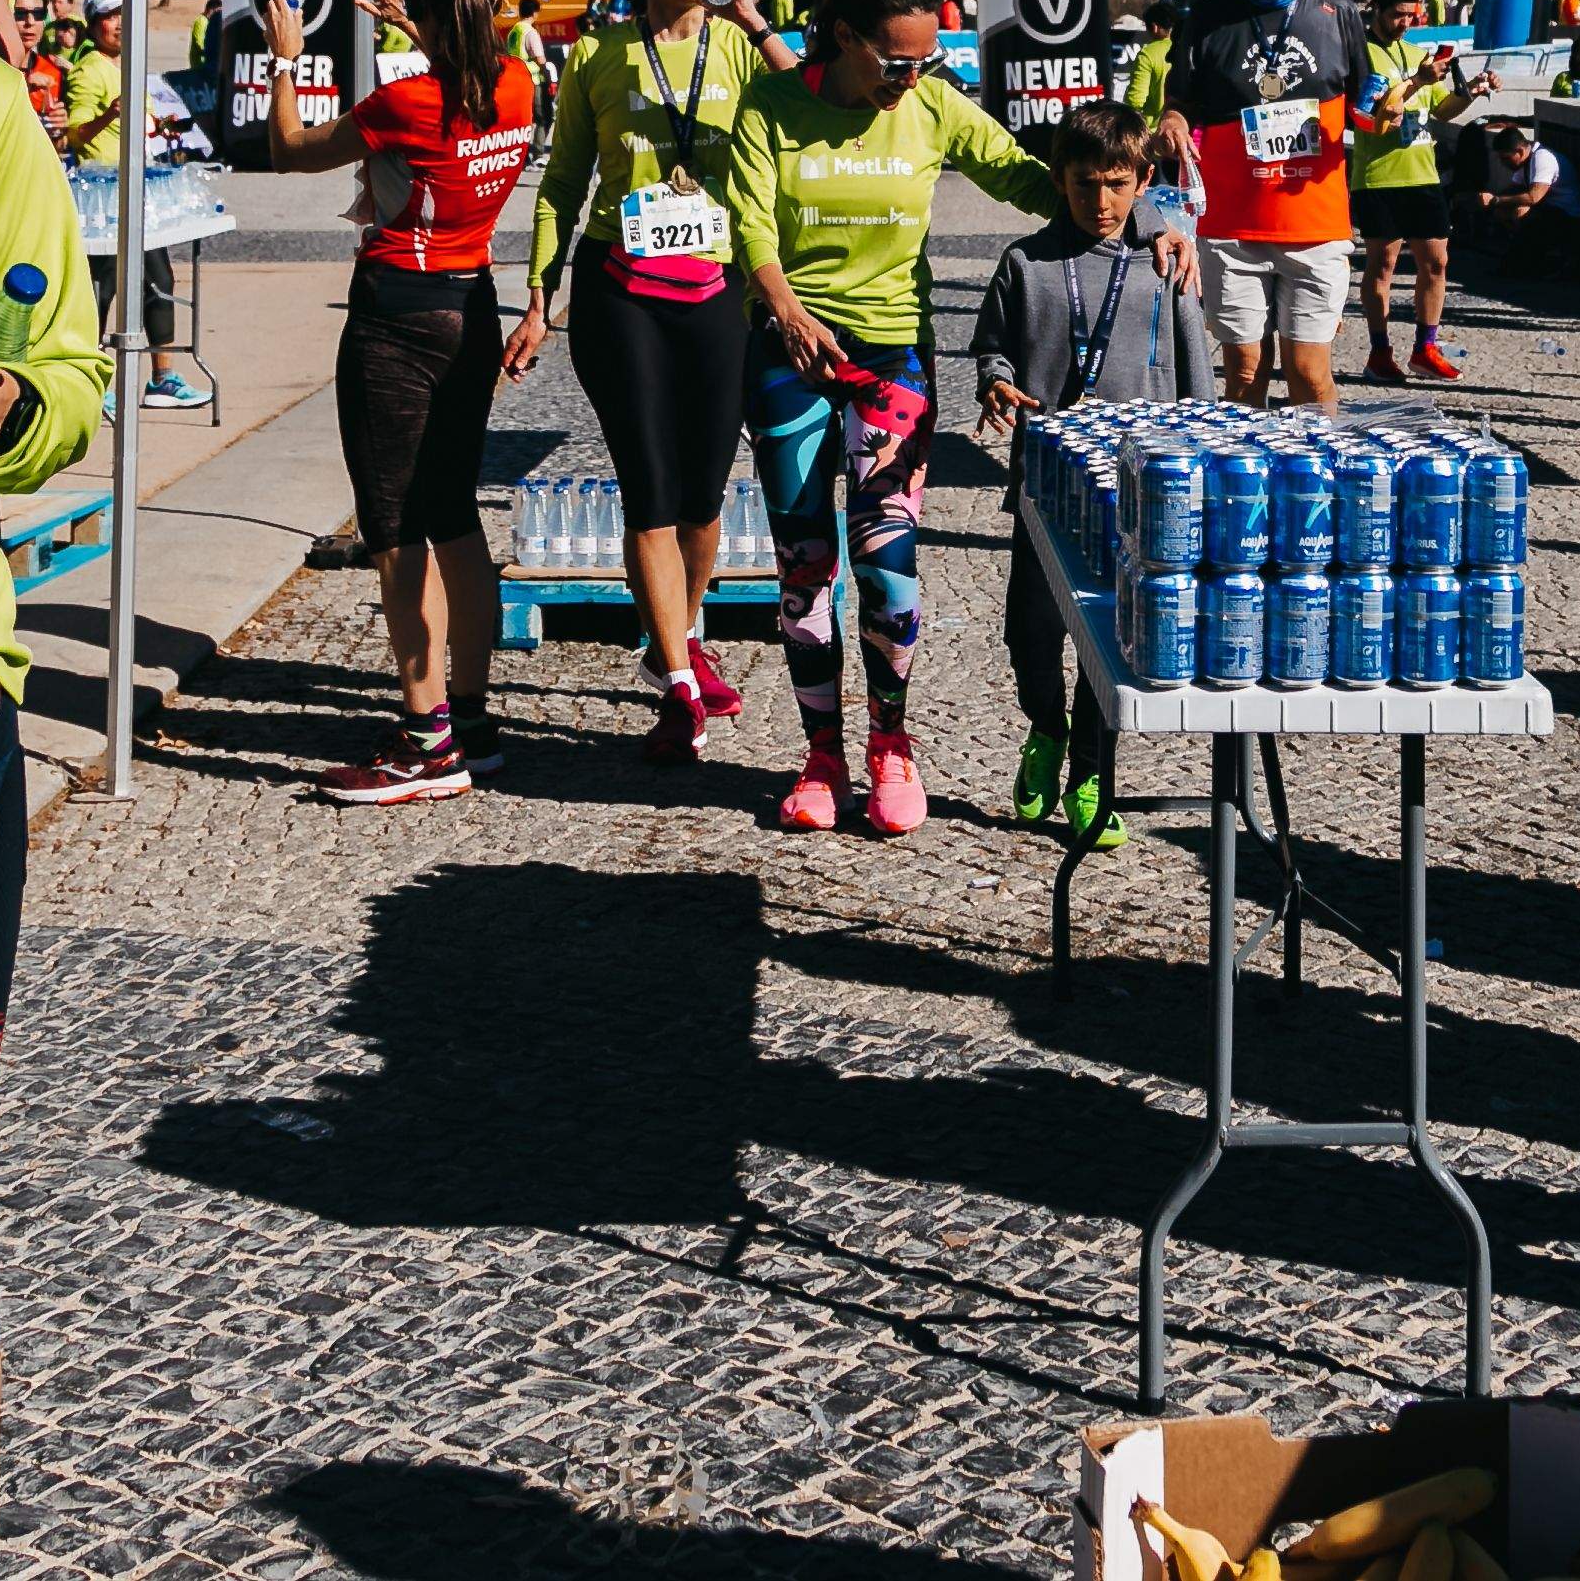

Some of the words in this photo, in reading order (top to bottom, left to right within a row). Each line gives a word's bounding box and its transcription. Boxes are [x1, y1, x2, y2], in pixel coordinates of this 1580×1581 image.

[234, 53, 334, 88] NEER
[1005, 57, 1099, 91] NEVER
[1008, 93, 1065, 132] give
[457, 124, 536, 159] RUNNING
[1265, 134, 1308, 156] 1020
[467, 148, 523, 178] RIVAS
[834, 156, 914, 178] MetLife
[850, 215, 889, 226] MADRID
[650, 222, 705, 251] 3221
